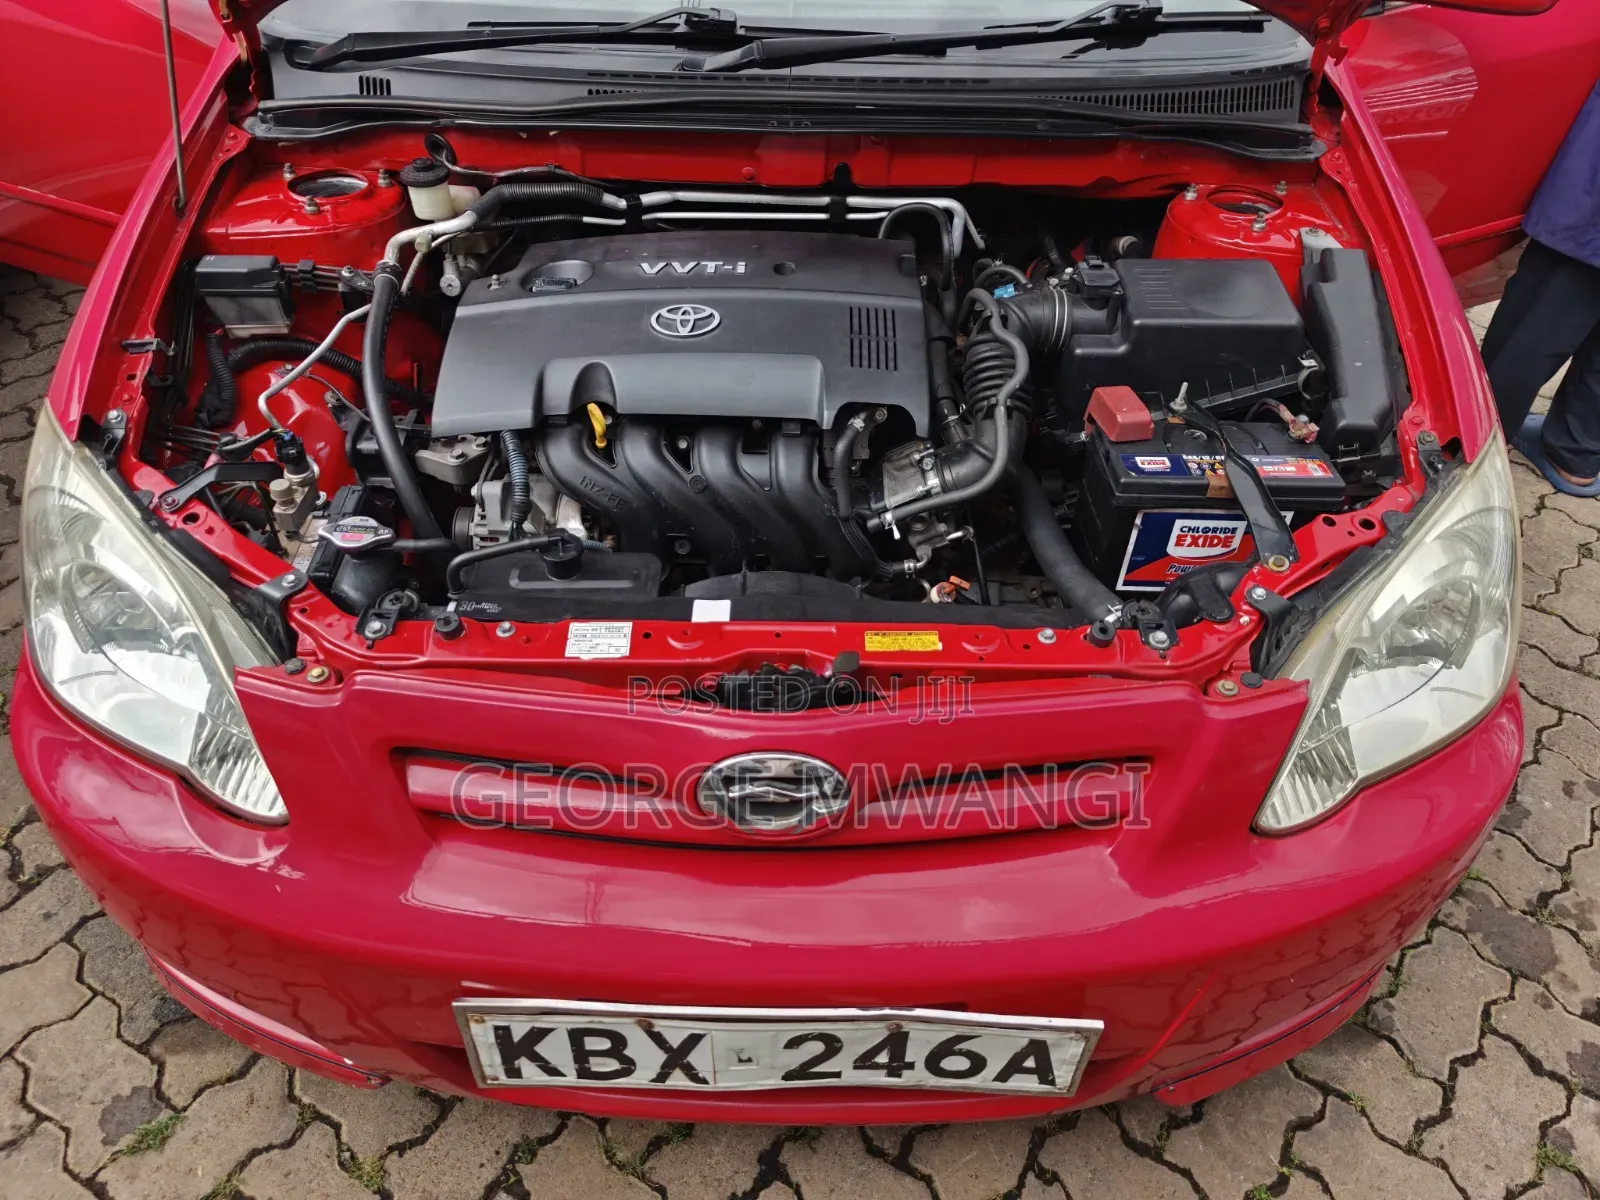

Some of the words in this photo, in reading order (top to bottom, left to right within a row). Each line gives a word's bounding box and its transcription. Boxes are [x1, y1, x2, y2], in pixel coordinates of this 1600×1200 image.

[640, 261, 746, 275] VVT-i
[1179, 525, 1239, 535] CHLORIDE
[1173, 533, 1237, 549] EXIDE
[492, 1023, 711, 1086] KBX
[781, 1029, 1057, 1087] 246A
